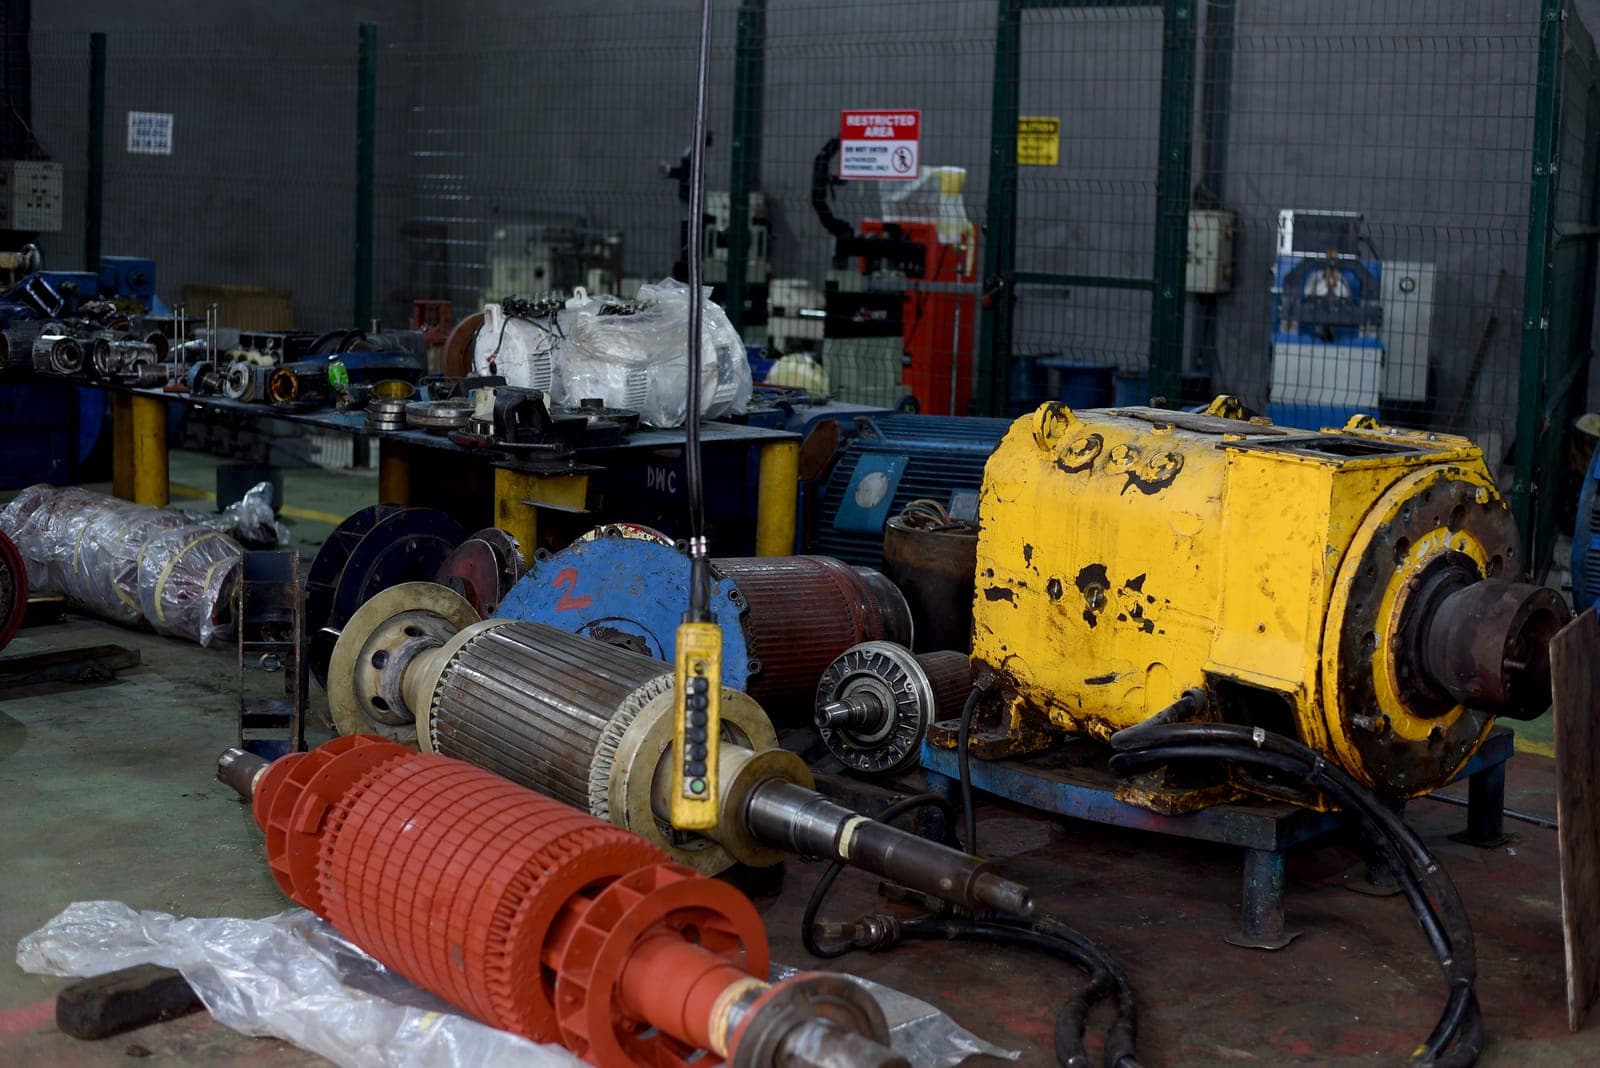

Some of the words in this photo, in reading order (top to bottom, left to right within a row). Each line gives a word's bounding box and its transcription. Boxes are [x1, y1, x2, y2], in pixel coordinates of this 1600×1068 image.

[846, 115, 915, 127] RESTRICTED
[864, 127, 895, 138] AREA
[551, 567, 594, 612] 2
